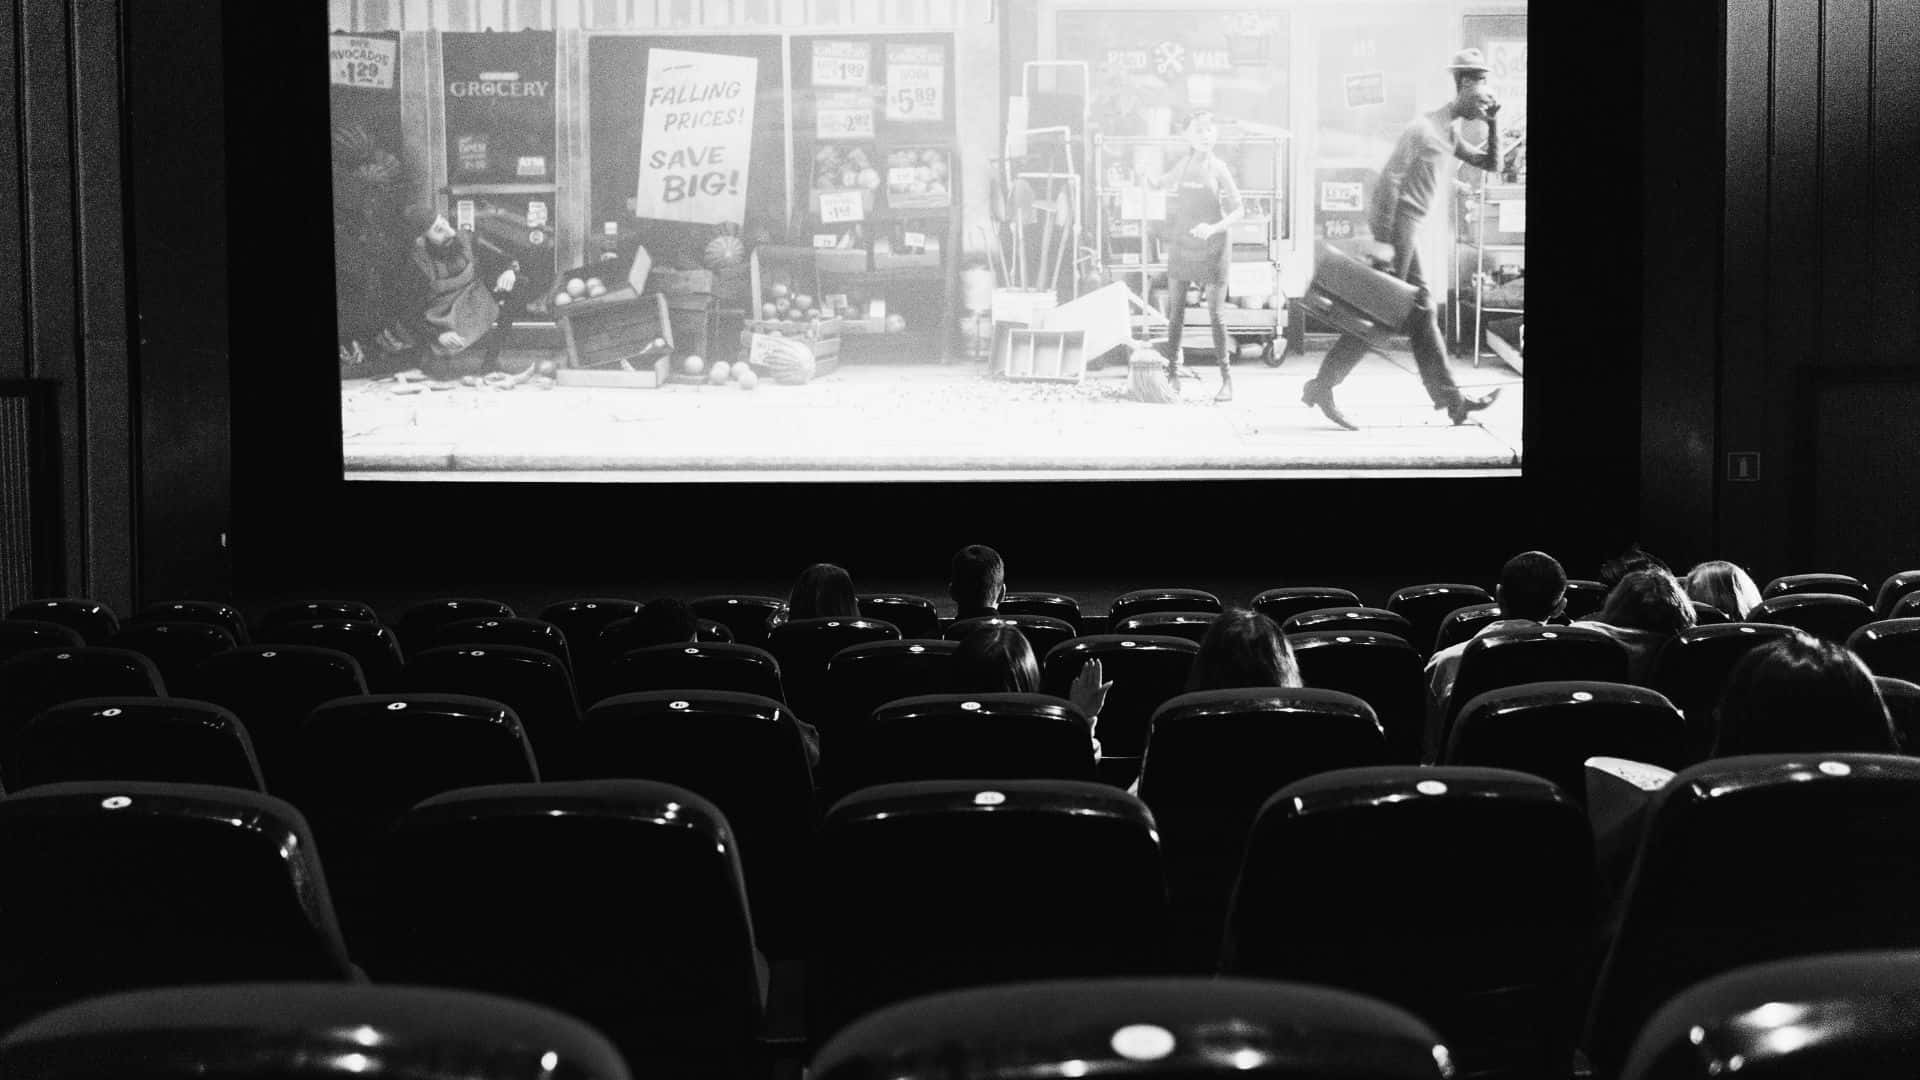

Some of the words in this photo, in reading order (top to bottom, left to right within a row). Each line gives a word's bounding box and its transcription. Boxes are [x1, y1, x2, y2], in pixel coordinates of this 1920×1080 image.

[450, 81, 548, 97] GROCERY
[649, 81, 741, 107] FALLING
[664, 107, 744, 132] PRICES!
[649, 146, 725, 170] SAVE
[662, 169, 739, 203] BIG!
